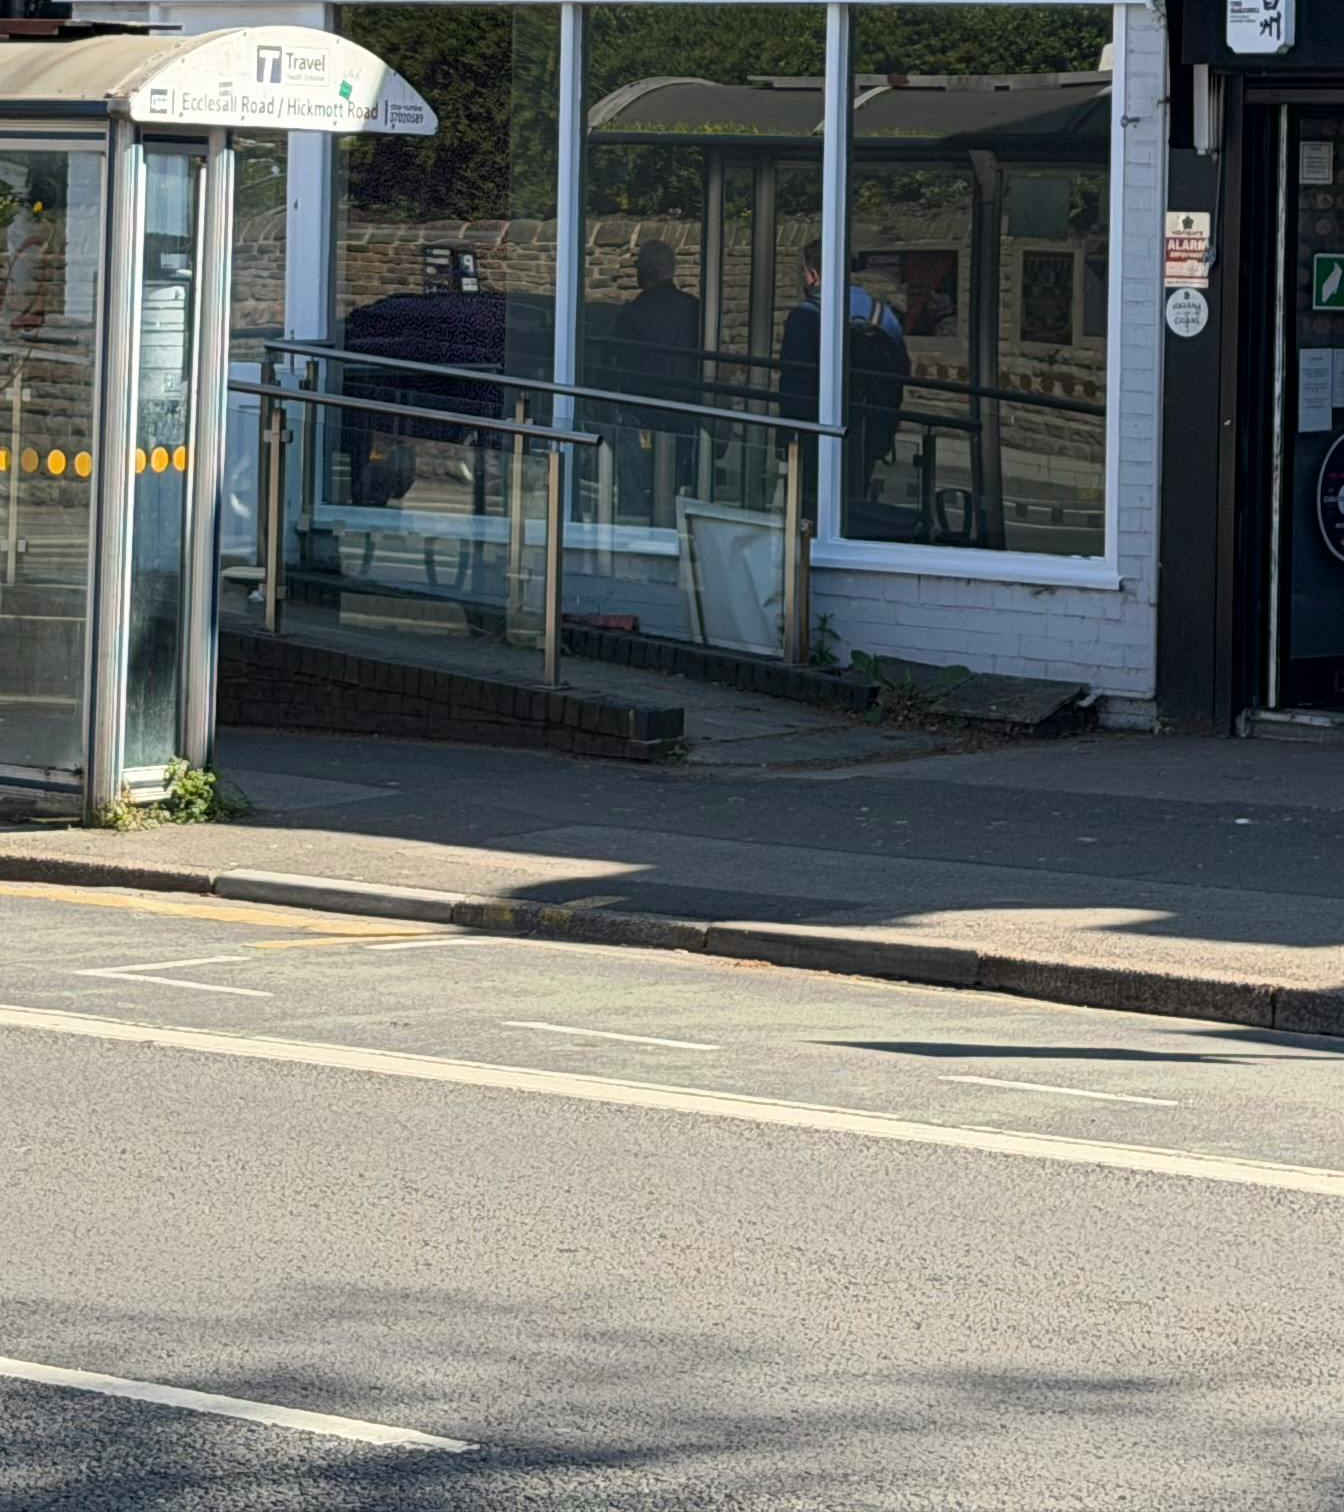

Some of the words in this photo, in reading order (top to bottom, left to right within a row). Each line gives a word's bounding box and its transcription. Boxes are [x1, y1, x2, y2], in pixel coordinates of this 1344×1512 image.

[286, 52, 325, 72] Travel
[182, 92, 237, 113] Ecclesall
[241, 95, 275, 114] Road
[277, 97, 284, 118] /
[287, 97, 344, 118] Hickmott
[347, 100, 379, 120] Road
